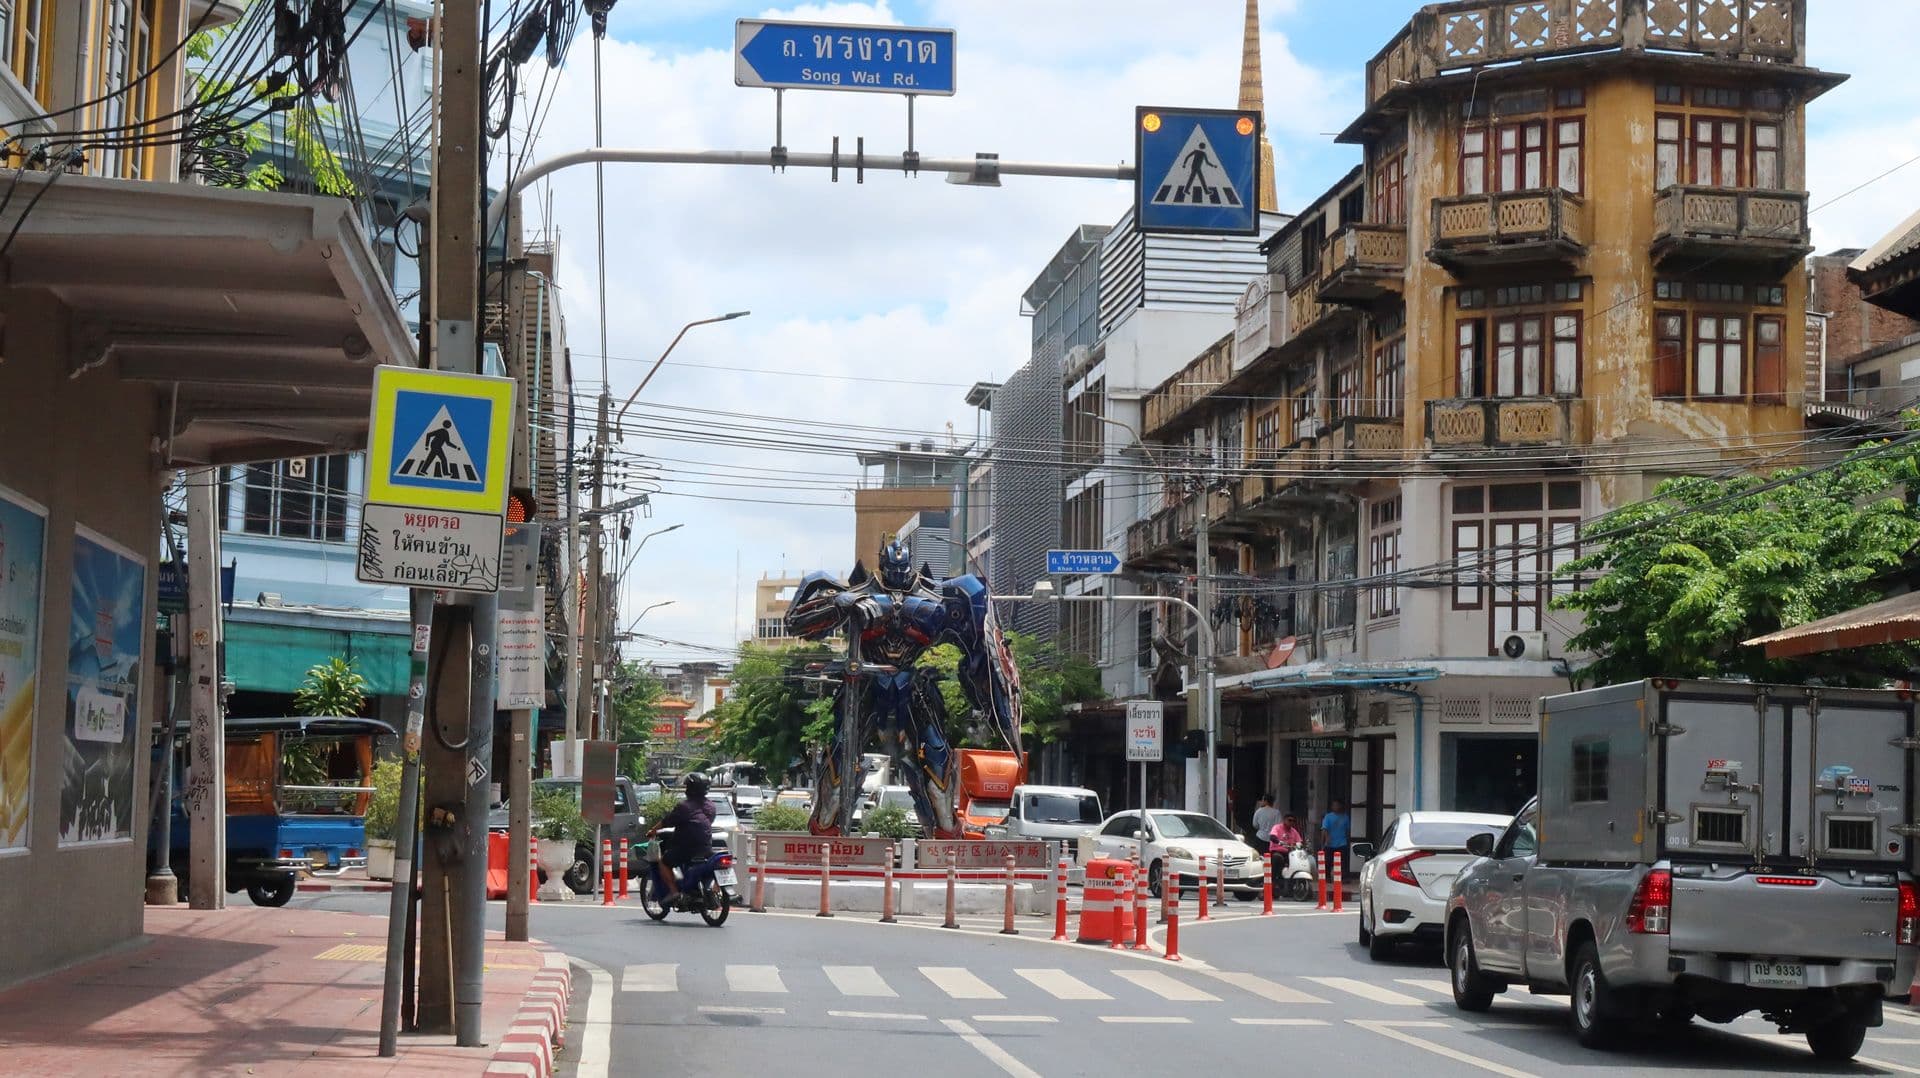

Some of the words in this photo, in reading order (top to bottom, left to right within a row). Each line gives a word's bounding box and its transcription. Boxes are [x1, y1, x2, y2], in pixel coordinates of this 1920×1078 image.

[783, 39, 803, 57] ถ.
[813, 34, 937, 64] ทรงวาด
[801, 68, 840, 84] Song
[852, 71, 881, 84] Wat
[893, 74, 919, 86] Rd.
[404, 512, 460, 533] หยุดรอ
[393, 529, 471, 557] ให้คนข้าม
[1062, 552, 1112, 565] ข้าวหลาม
[394, 558, 469, 584] ก่อนเลี้ยว
[1133, 725, 1156, 739] ระวัง
[1776, 965, 1801, 977] 9333
